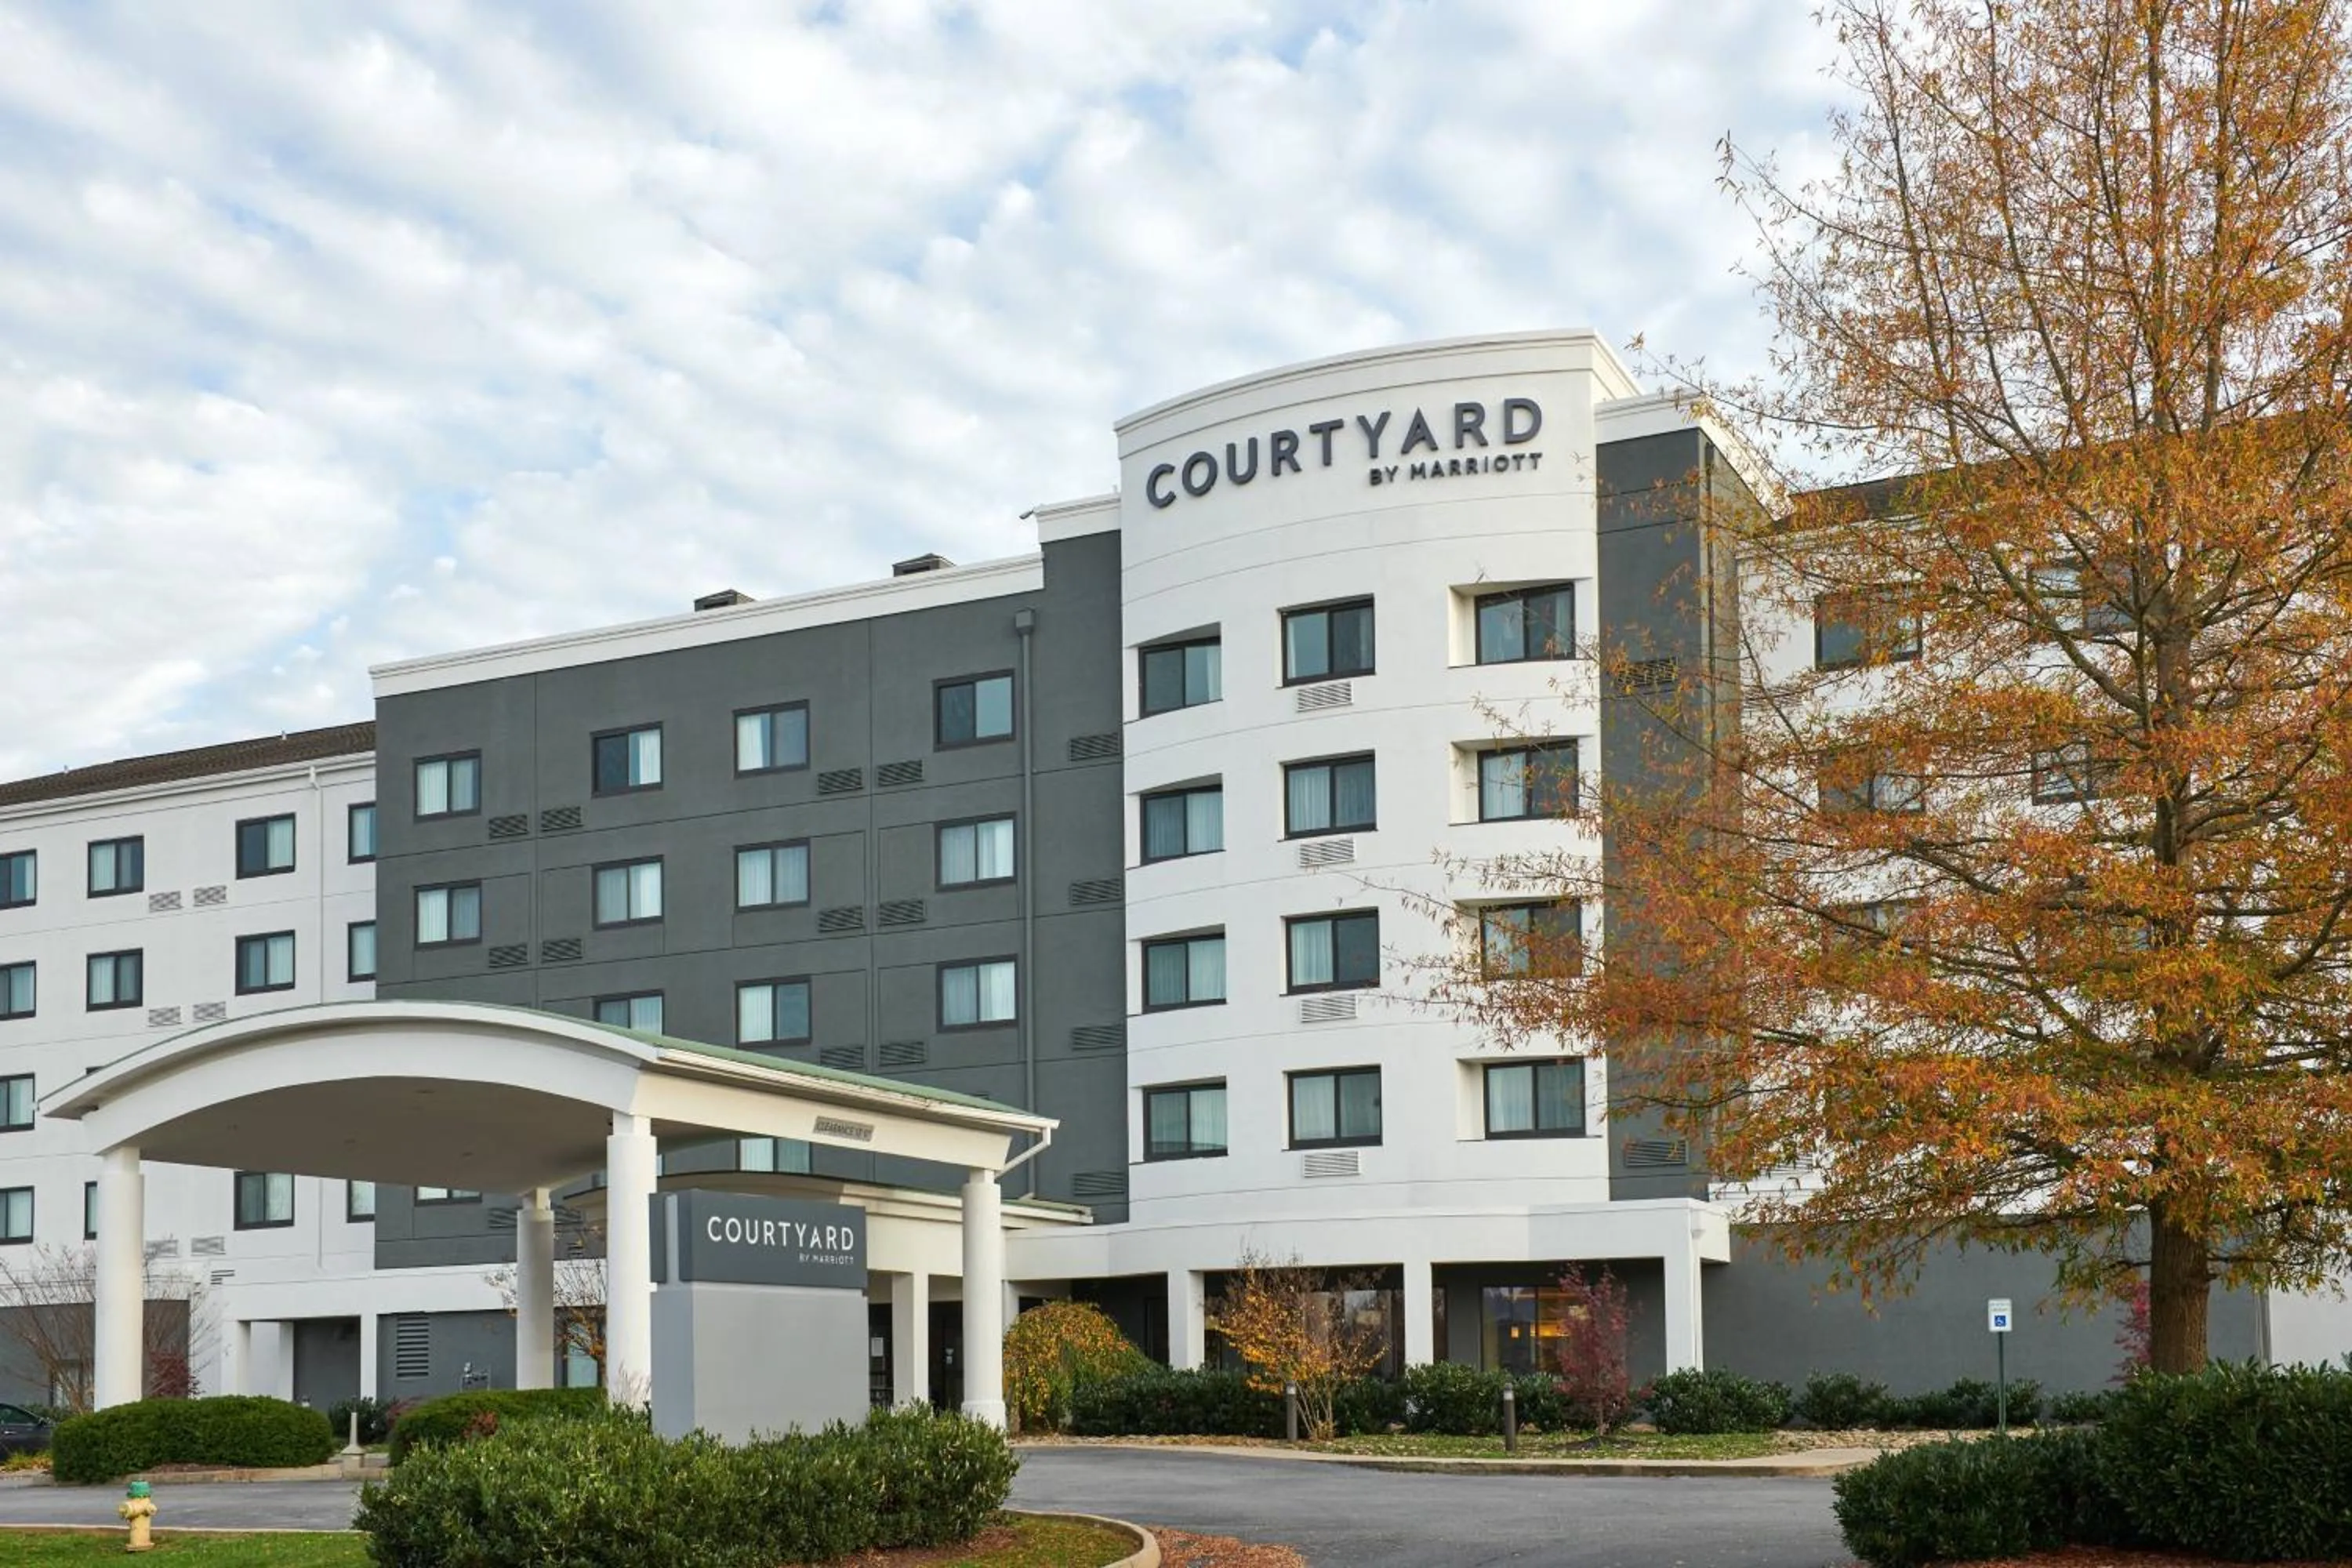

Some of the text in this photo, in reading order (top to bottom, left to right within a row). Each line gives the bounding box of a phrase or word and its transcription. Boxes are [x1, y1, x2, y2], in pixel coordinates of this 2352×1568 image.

[1145, 397, 1543, 509] COURTYARD
[1370, 452, 1543, 486] BY MARRIOTT
[707, 1215, 855, 1251] COURTYARD
[799, 1253, 855, 1265] BY MARRIOTT
